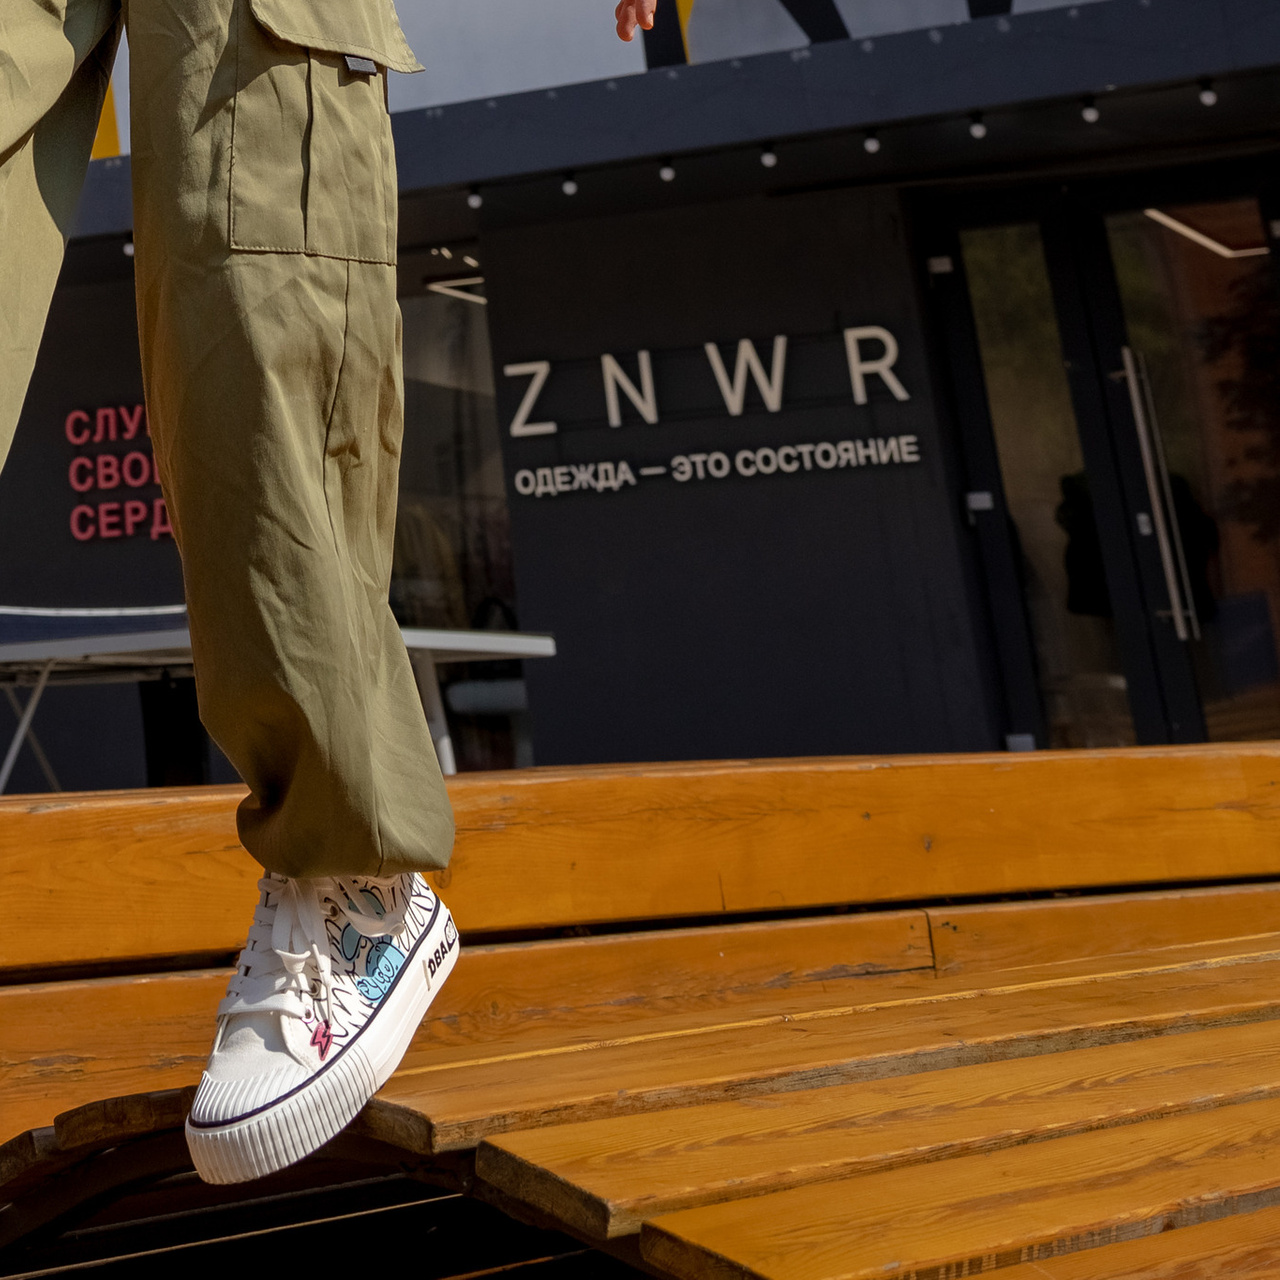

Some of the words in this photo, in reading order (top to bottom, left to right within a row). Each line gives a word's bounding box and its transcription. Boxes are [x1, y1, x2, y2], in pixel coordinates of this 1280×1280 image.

[503, 325, 911, 437] ZNWR
[65, 404, 151, 445] СЛУ
[68, 451, 161, 492] СВО
[514, 461, 637, 497] ОДЕЖДА
[671, 451, 731, 482] ЭТО
[735, 435, 921, 477] СОСТОЯНИЕ
